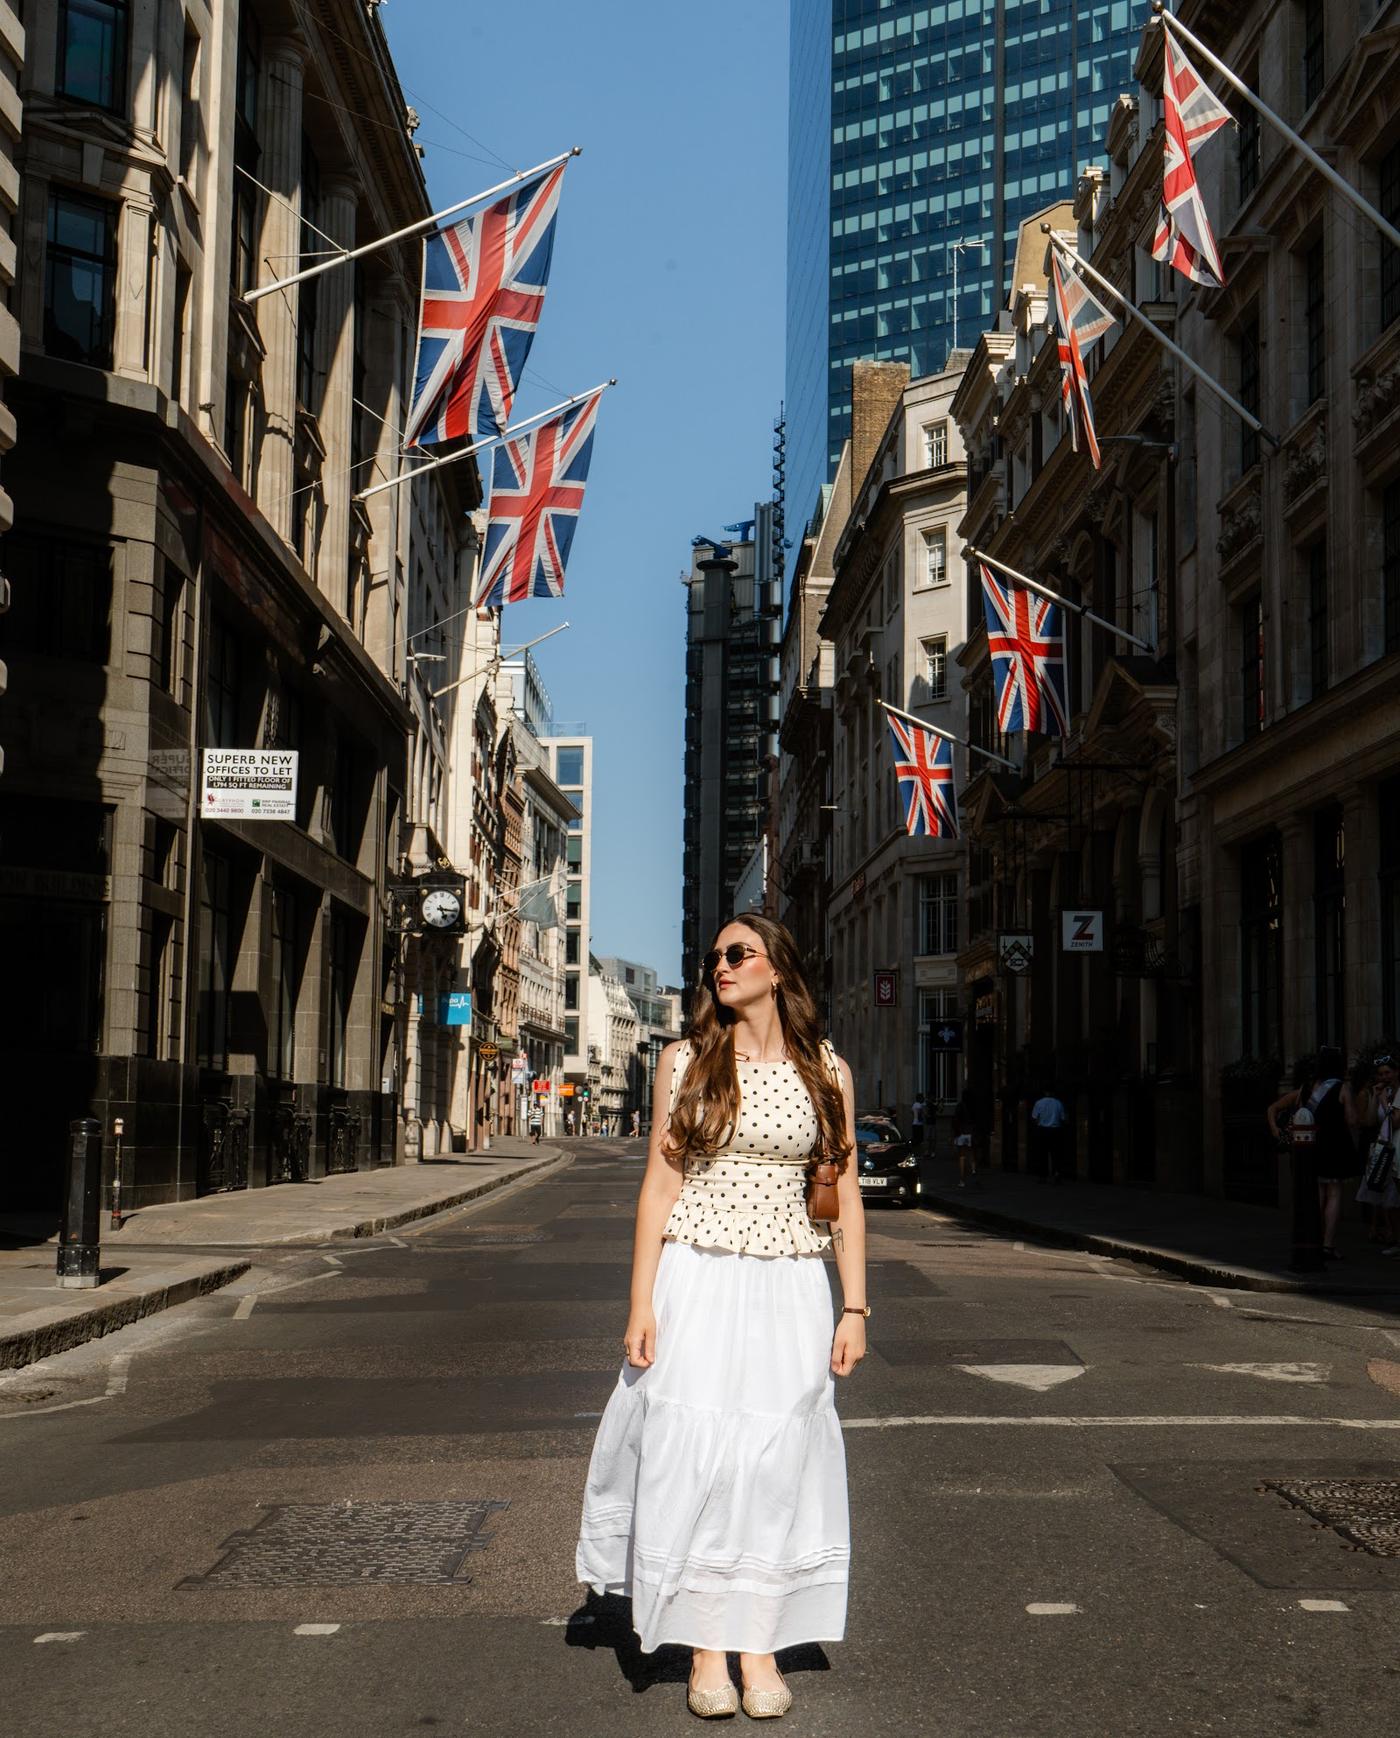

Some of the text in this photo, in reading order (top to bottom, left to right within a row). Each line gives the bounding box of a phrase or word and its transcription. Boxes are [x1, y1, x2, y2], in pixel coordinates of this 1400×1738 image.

[207, 754, 292, 765] SUPERB NEW
[207, 766, 292, 776] OFFICES TO LET
[1072, 915, 1095, 940] Z
